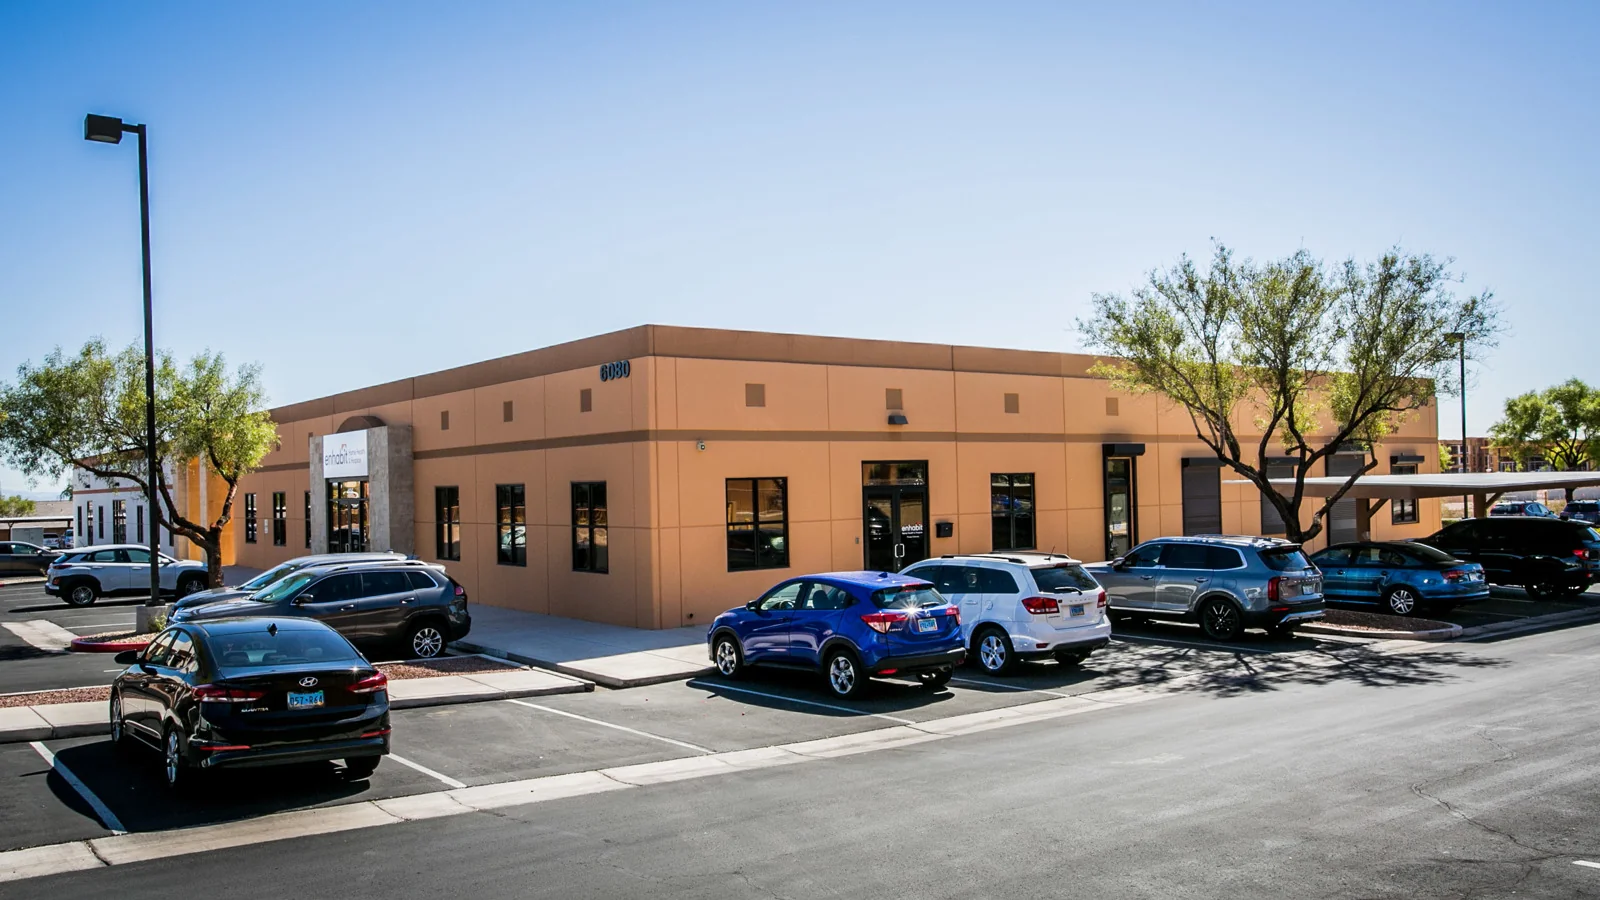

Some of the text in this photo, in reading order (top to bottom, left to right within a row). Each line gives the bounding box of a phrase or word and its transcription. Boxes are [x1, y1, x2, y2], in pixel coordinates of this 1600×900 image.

[600, 360, 631, 382] 6080
[325, 448, 348, 466] enhabit
[901, 524, 923, 532] enhabit
